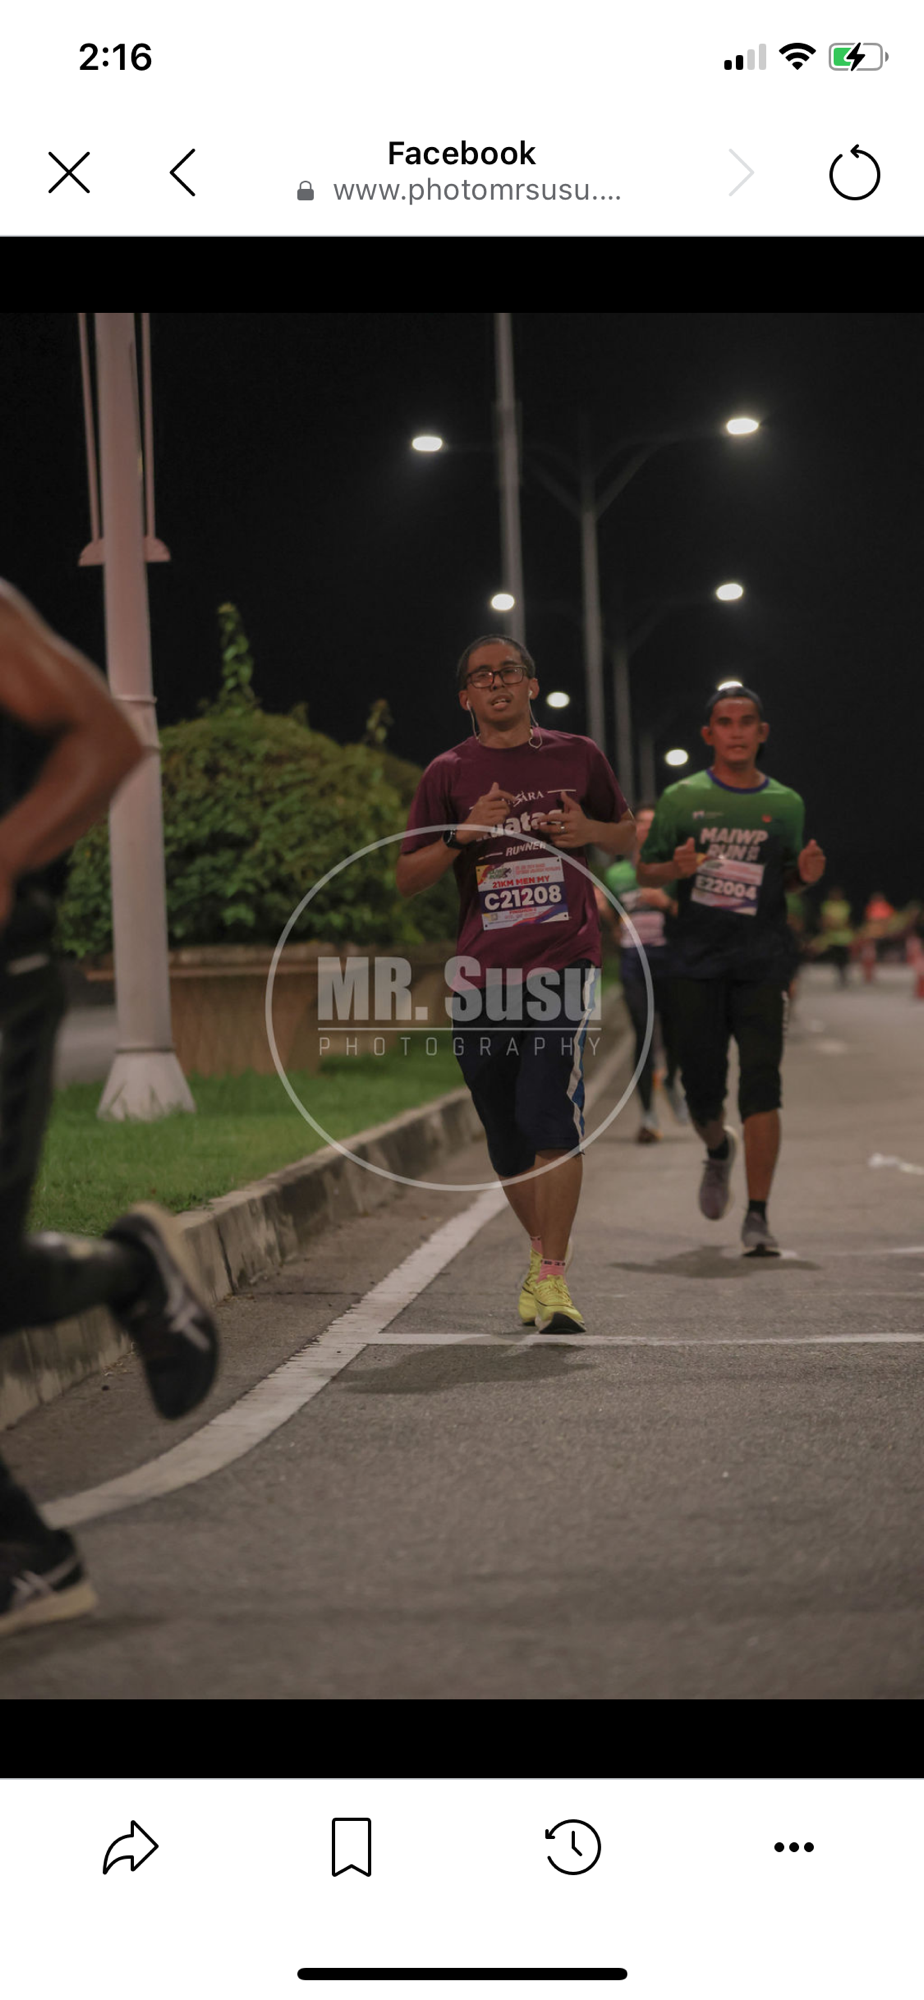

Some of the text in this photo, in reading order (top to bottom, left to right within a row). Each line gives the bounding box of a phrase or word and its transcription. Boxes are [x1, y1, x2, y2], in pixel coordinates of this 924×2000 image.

[80, 43, 151, 71] 2:16
[389, 140, 536, 165] Facebook
[700, 827, 768, 845] MAIWP
[492, 875, 550, 889] 21KM MEN MY
[695, 875, 757, 900] E22004
[484, 884, 562, 910] C21208
